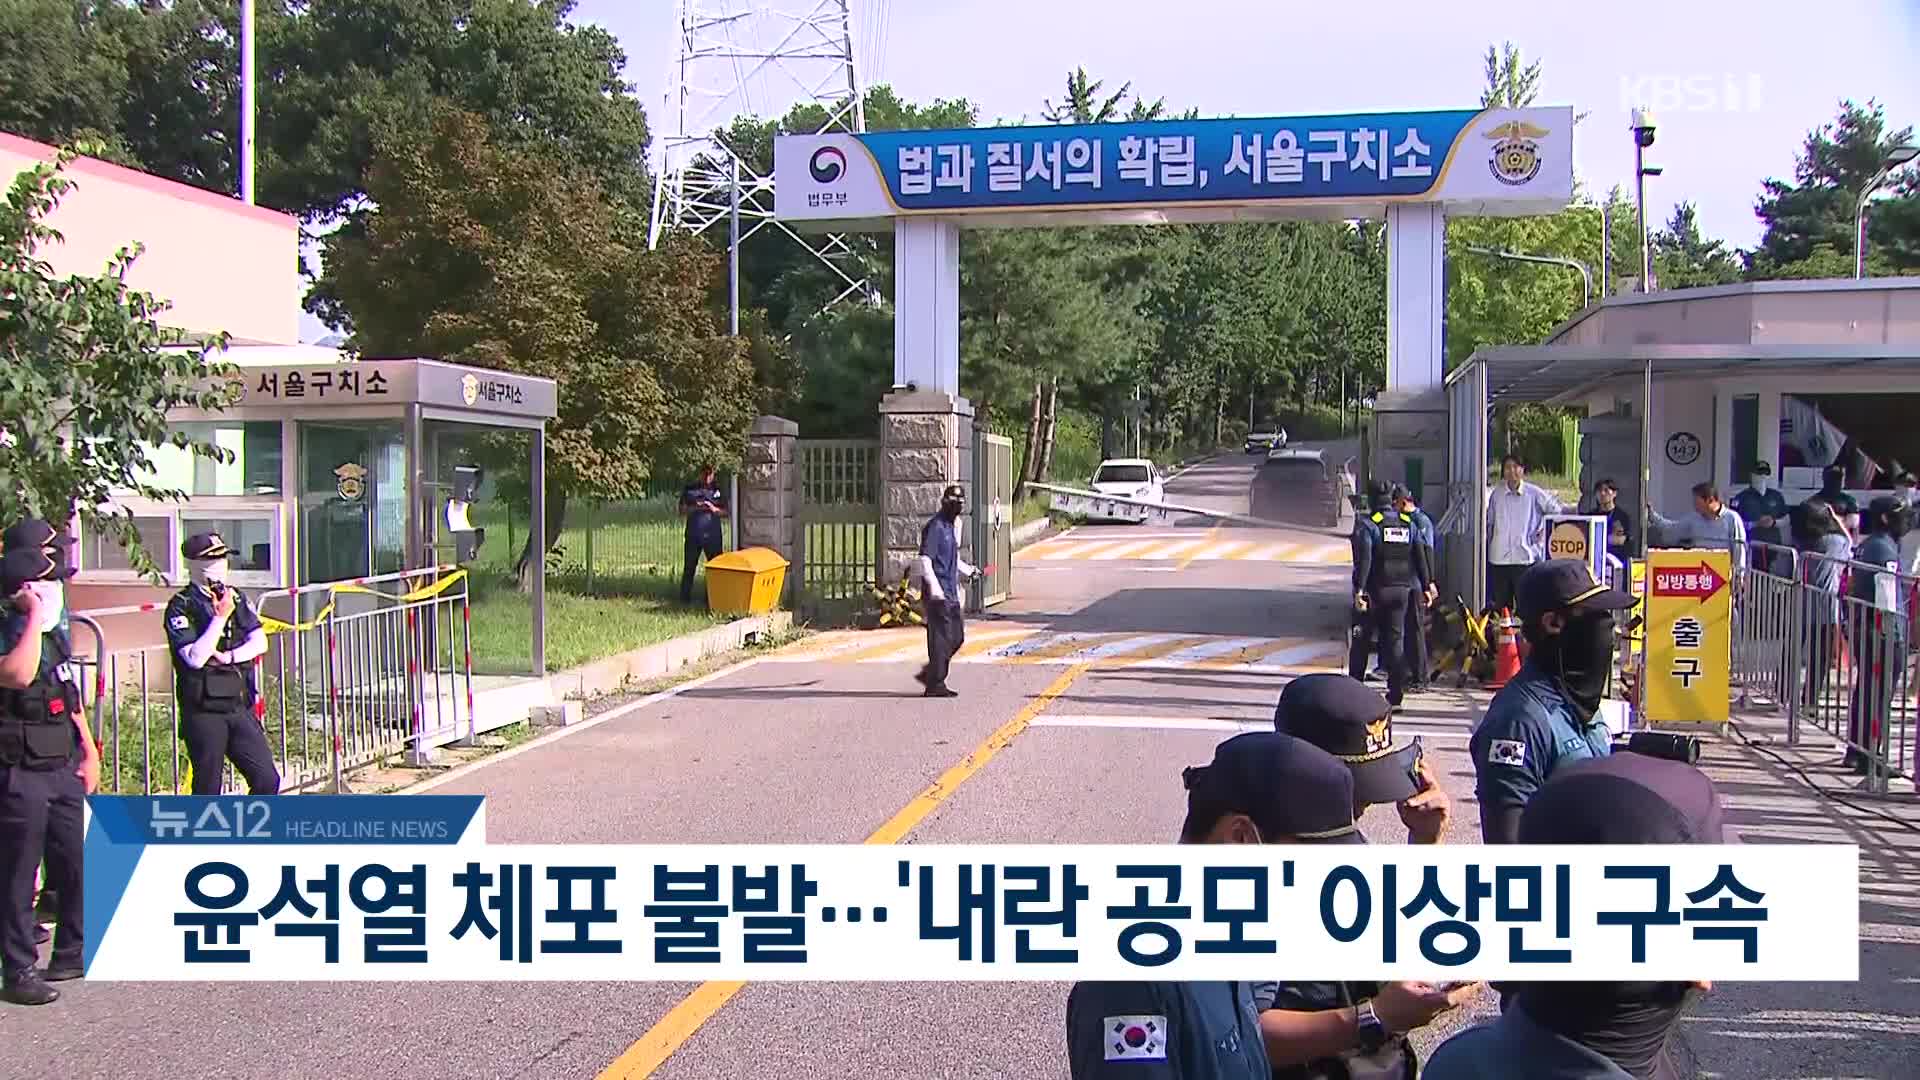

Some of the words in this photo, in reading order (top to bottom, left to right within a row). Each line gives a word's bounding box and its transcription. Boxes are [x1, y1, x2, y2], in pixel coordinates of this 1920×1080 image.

[898, 143, 975, 196] 법과
[987, 137, 1102, 192] 질서의
[1117, 134, 1208, 190] 확립,
[1223, 126, 1433, 185] 서울구치소
[807, 191, 849, 208] 법무부
[256, 369, 389, 398] 서울구치소
[478, 382, 523, 405] 서울구치소
[1550, 539, 1584, 554] STOP
[1655, 573, 1714, 591] 일방통행
